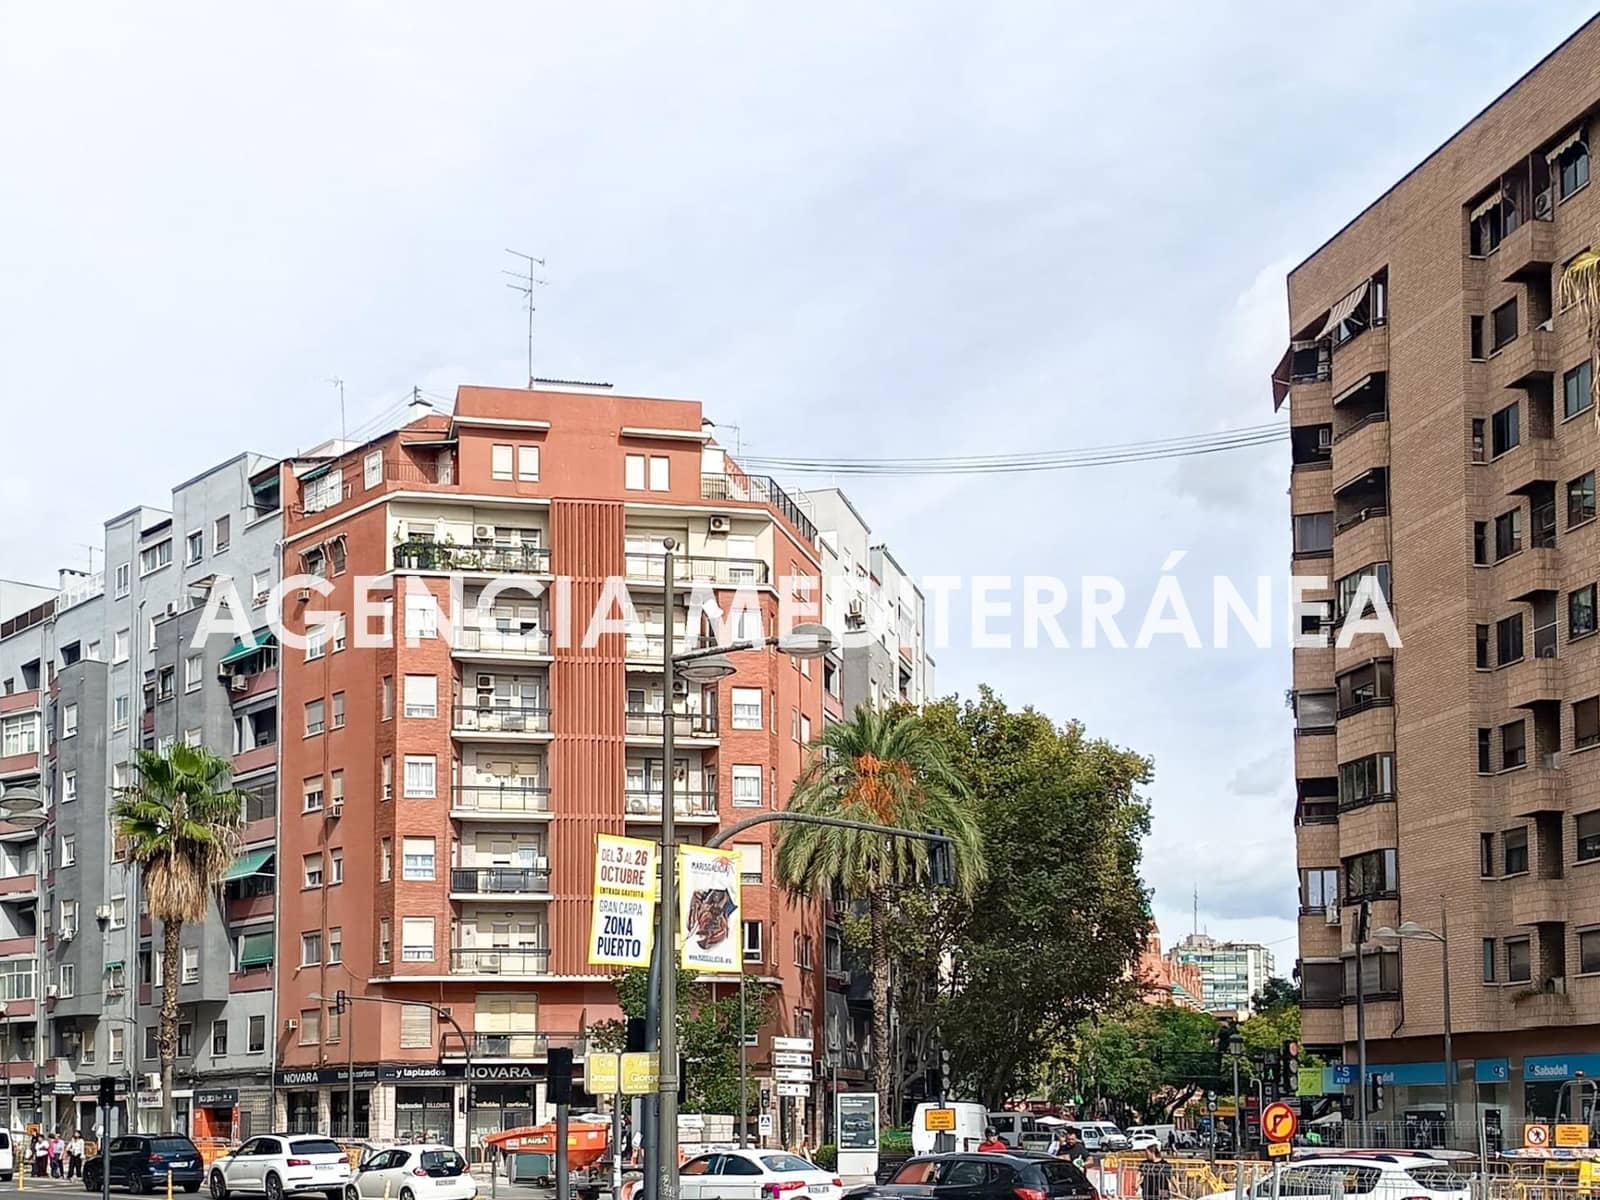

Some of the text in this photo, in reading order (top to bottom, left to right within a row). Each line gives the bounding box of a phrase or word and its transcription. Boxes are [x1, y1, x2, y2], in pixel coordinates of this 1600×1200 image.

[601, 847, 648, 866] DEL 3 AL 26
[601, 865, 645, 886] OCTUBRE
[600, 886, 644, 898] ENTRADA GRATUITA
[599, 899, 643, 916] GRAN CARPA
[604, 915, 633, 936] ZONA
[597, 936, 641, 958] PUERTO
[396, 1068, 402, 1078] y
[403, 1067, 447, 1077] tapizados
[464, 1066, 532, 1078] NOVARA
[1534, 1063, 1569, 1076] Sabadell
[283, 1071, 319, 1084] NOVARA
[1368, 1071, 1395, 1083] Sdell
